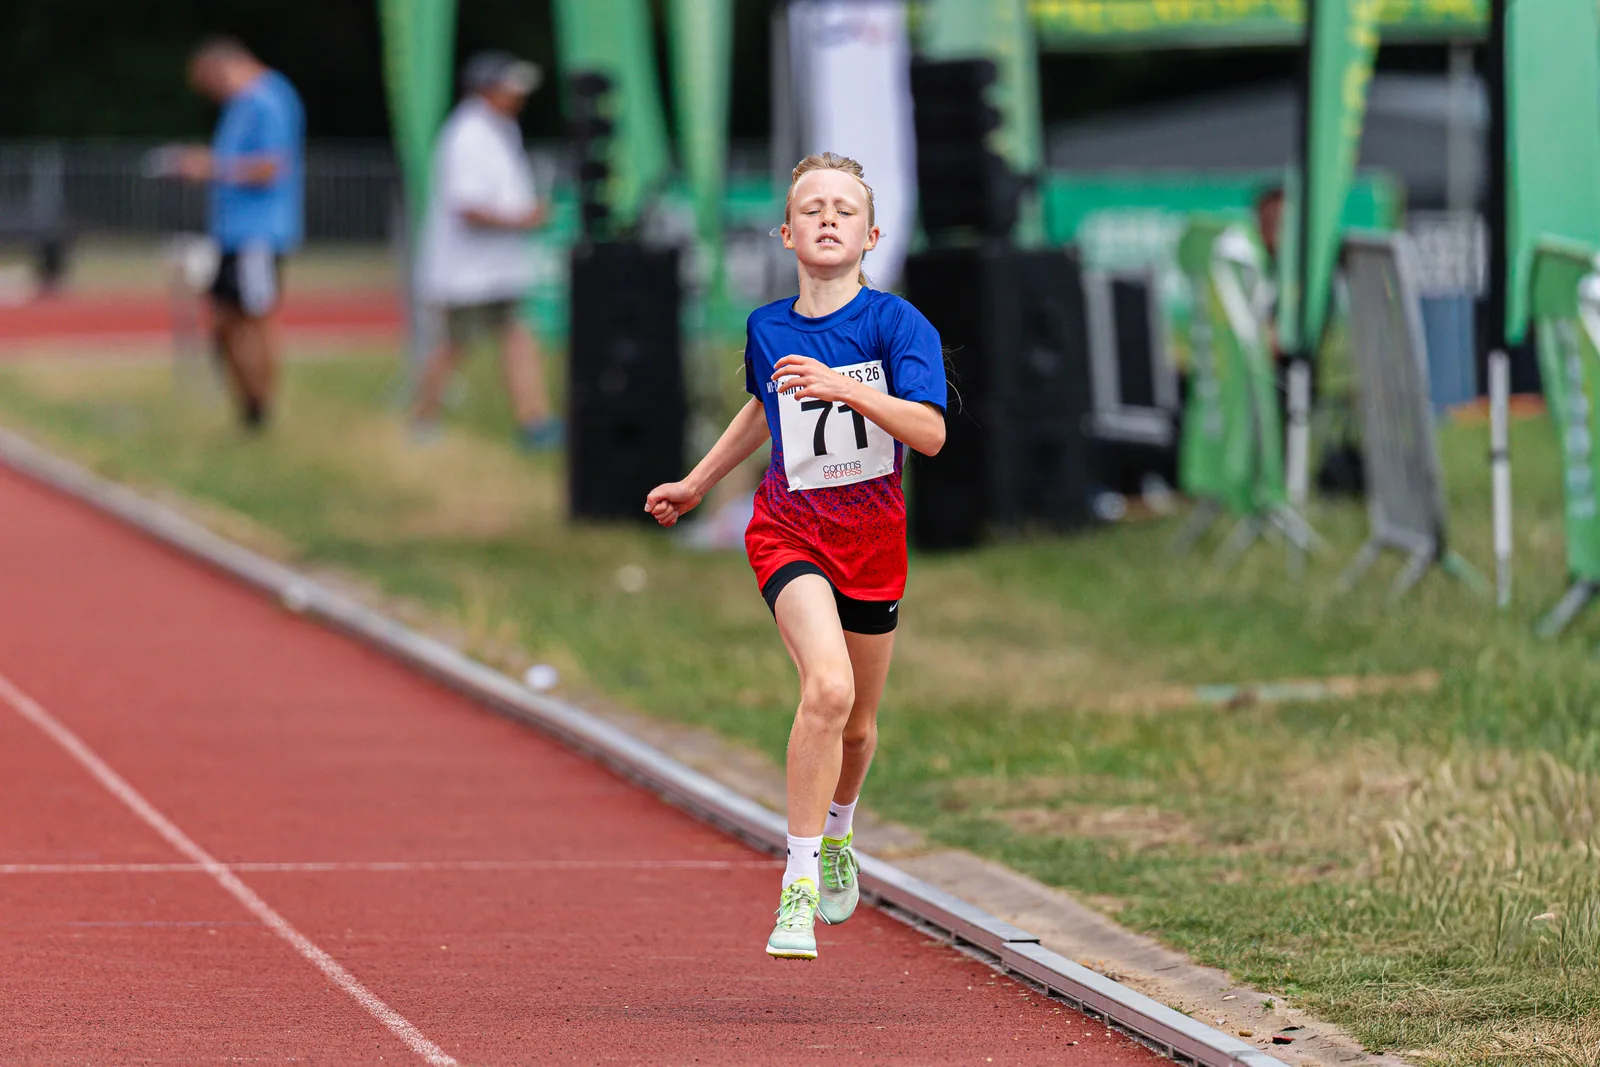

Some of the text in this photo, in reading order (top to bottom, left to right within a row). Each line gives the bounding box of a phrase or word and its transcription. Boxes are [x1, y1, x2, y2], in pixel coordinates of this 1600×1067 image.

[865, 366, 880, 382] 26
[801, 399, 869, 457] 71
[822, 460, 862, 474] comms
[823, 468, 863, 480] express
